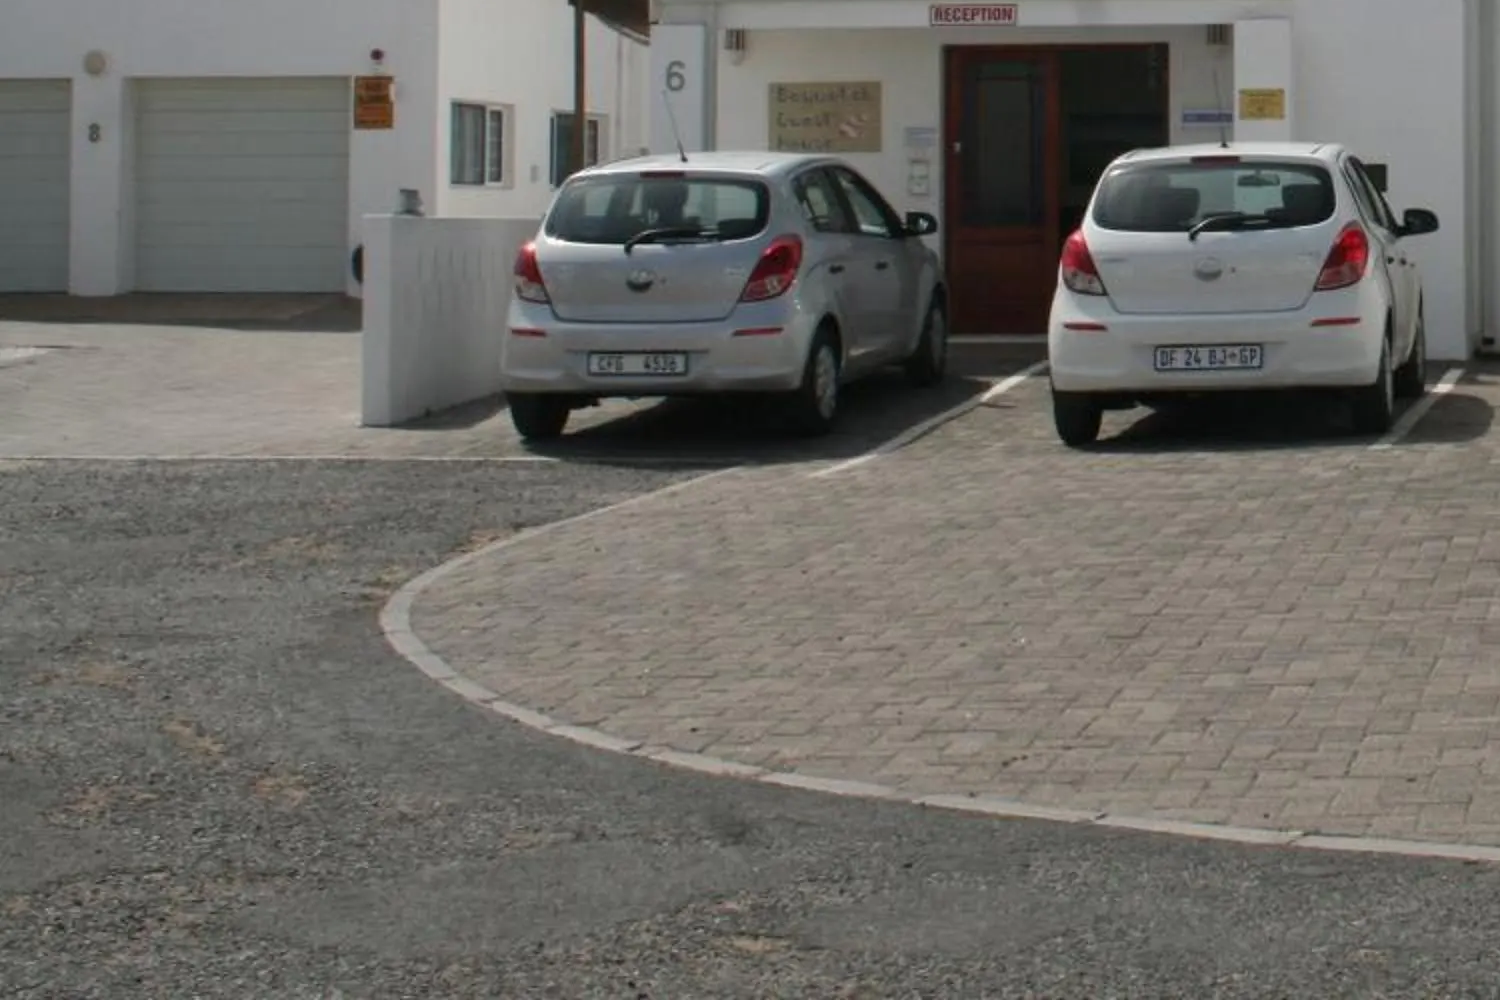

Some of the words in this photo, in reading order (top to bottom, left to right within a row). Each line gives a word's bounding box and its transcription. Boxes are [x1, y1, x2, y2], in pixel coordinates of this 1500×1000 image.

[933, 5, 1014, 22] RECEPTION
[665, 60, 686, 92] 6
[88, 122, 101, 144] 8
